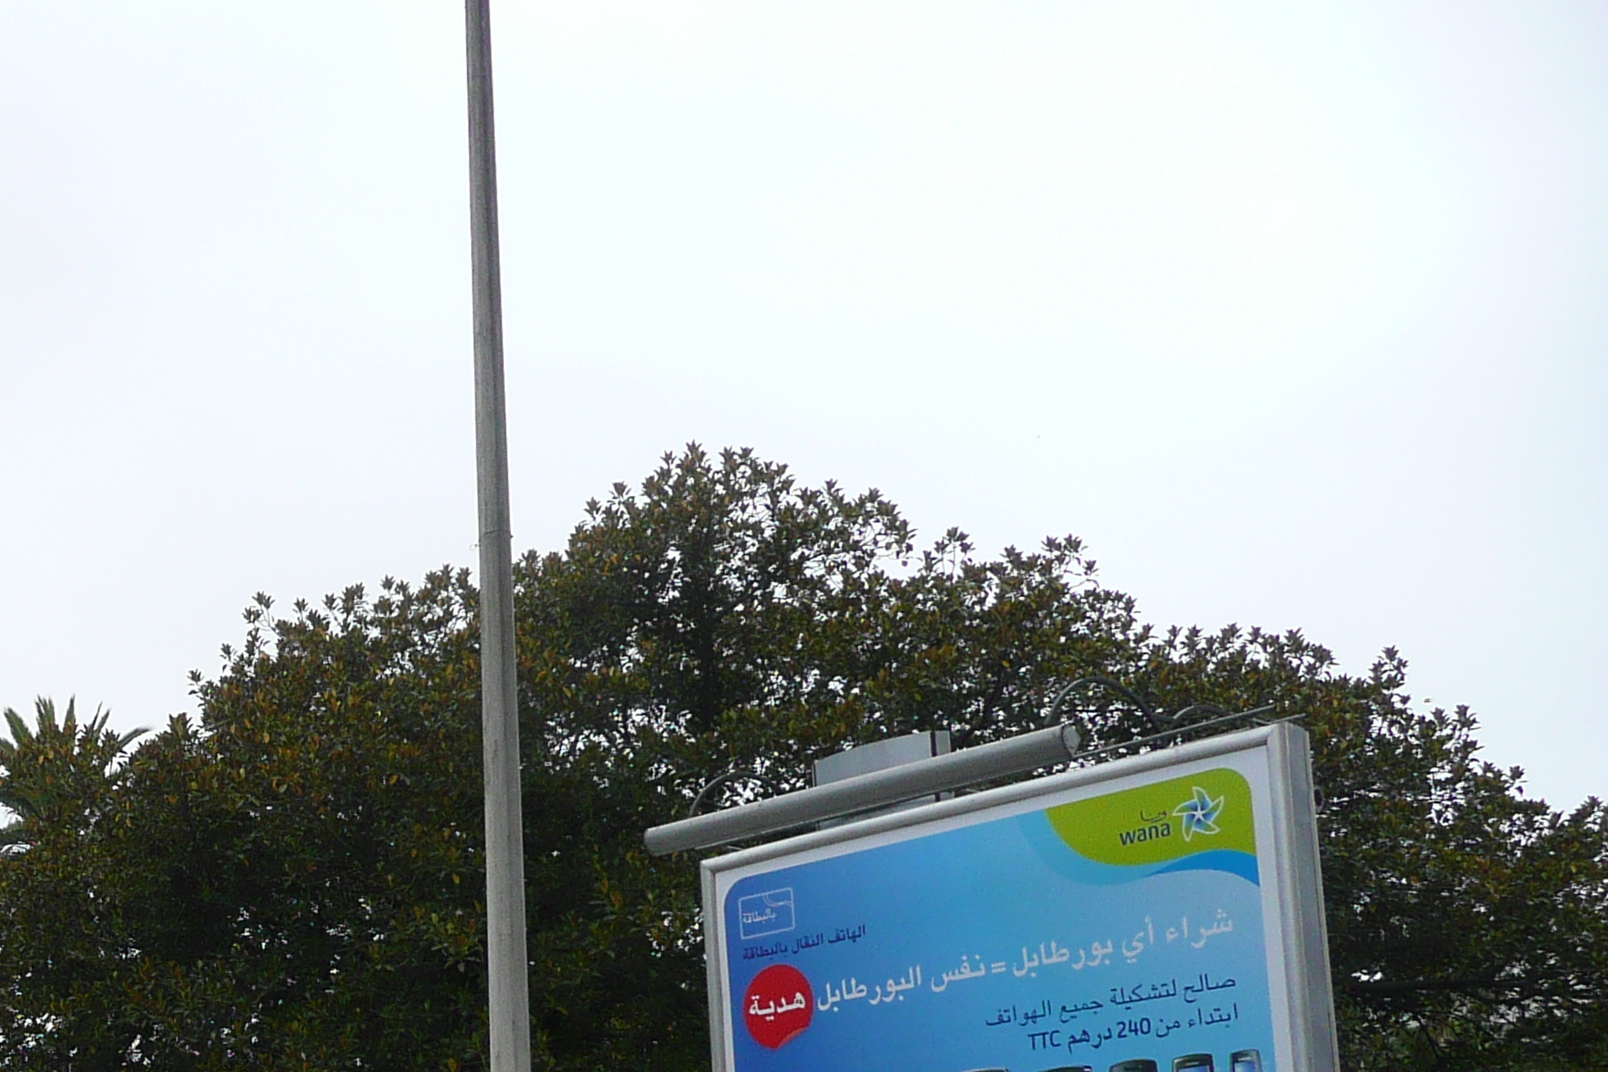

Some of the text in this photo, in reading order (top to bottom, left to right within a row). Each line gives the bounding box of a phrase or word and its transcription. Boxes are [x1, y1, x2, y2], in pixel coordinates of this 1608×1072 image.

[1119, 822, 1171, 846] wana
[743, 925, 866, 960] الهاتف النقال بالبطاقة
[1122, 915, 1154, 963] أي
[1165, 909, 1234, 948] شراء
[931, 955, 986, 992] نفس
[1013, 939, 1113, 978] بورطابل
[749, 992, 806, 1021] هدية
[817, 965, 922, 1012] البورطابل
[985, 973, 1236, 1027] صالح لتشكيلة جميع الهواتف
[1028, 1003, 1238, 1054] ابتداء من 240 درهم TTC
